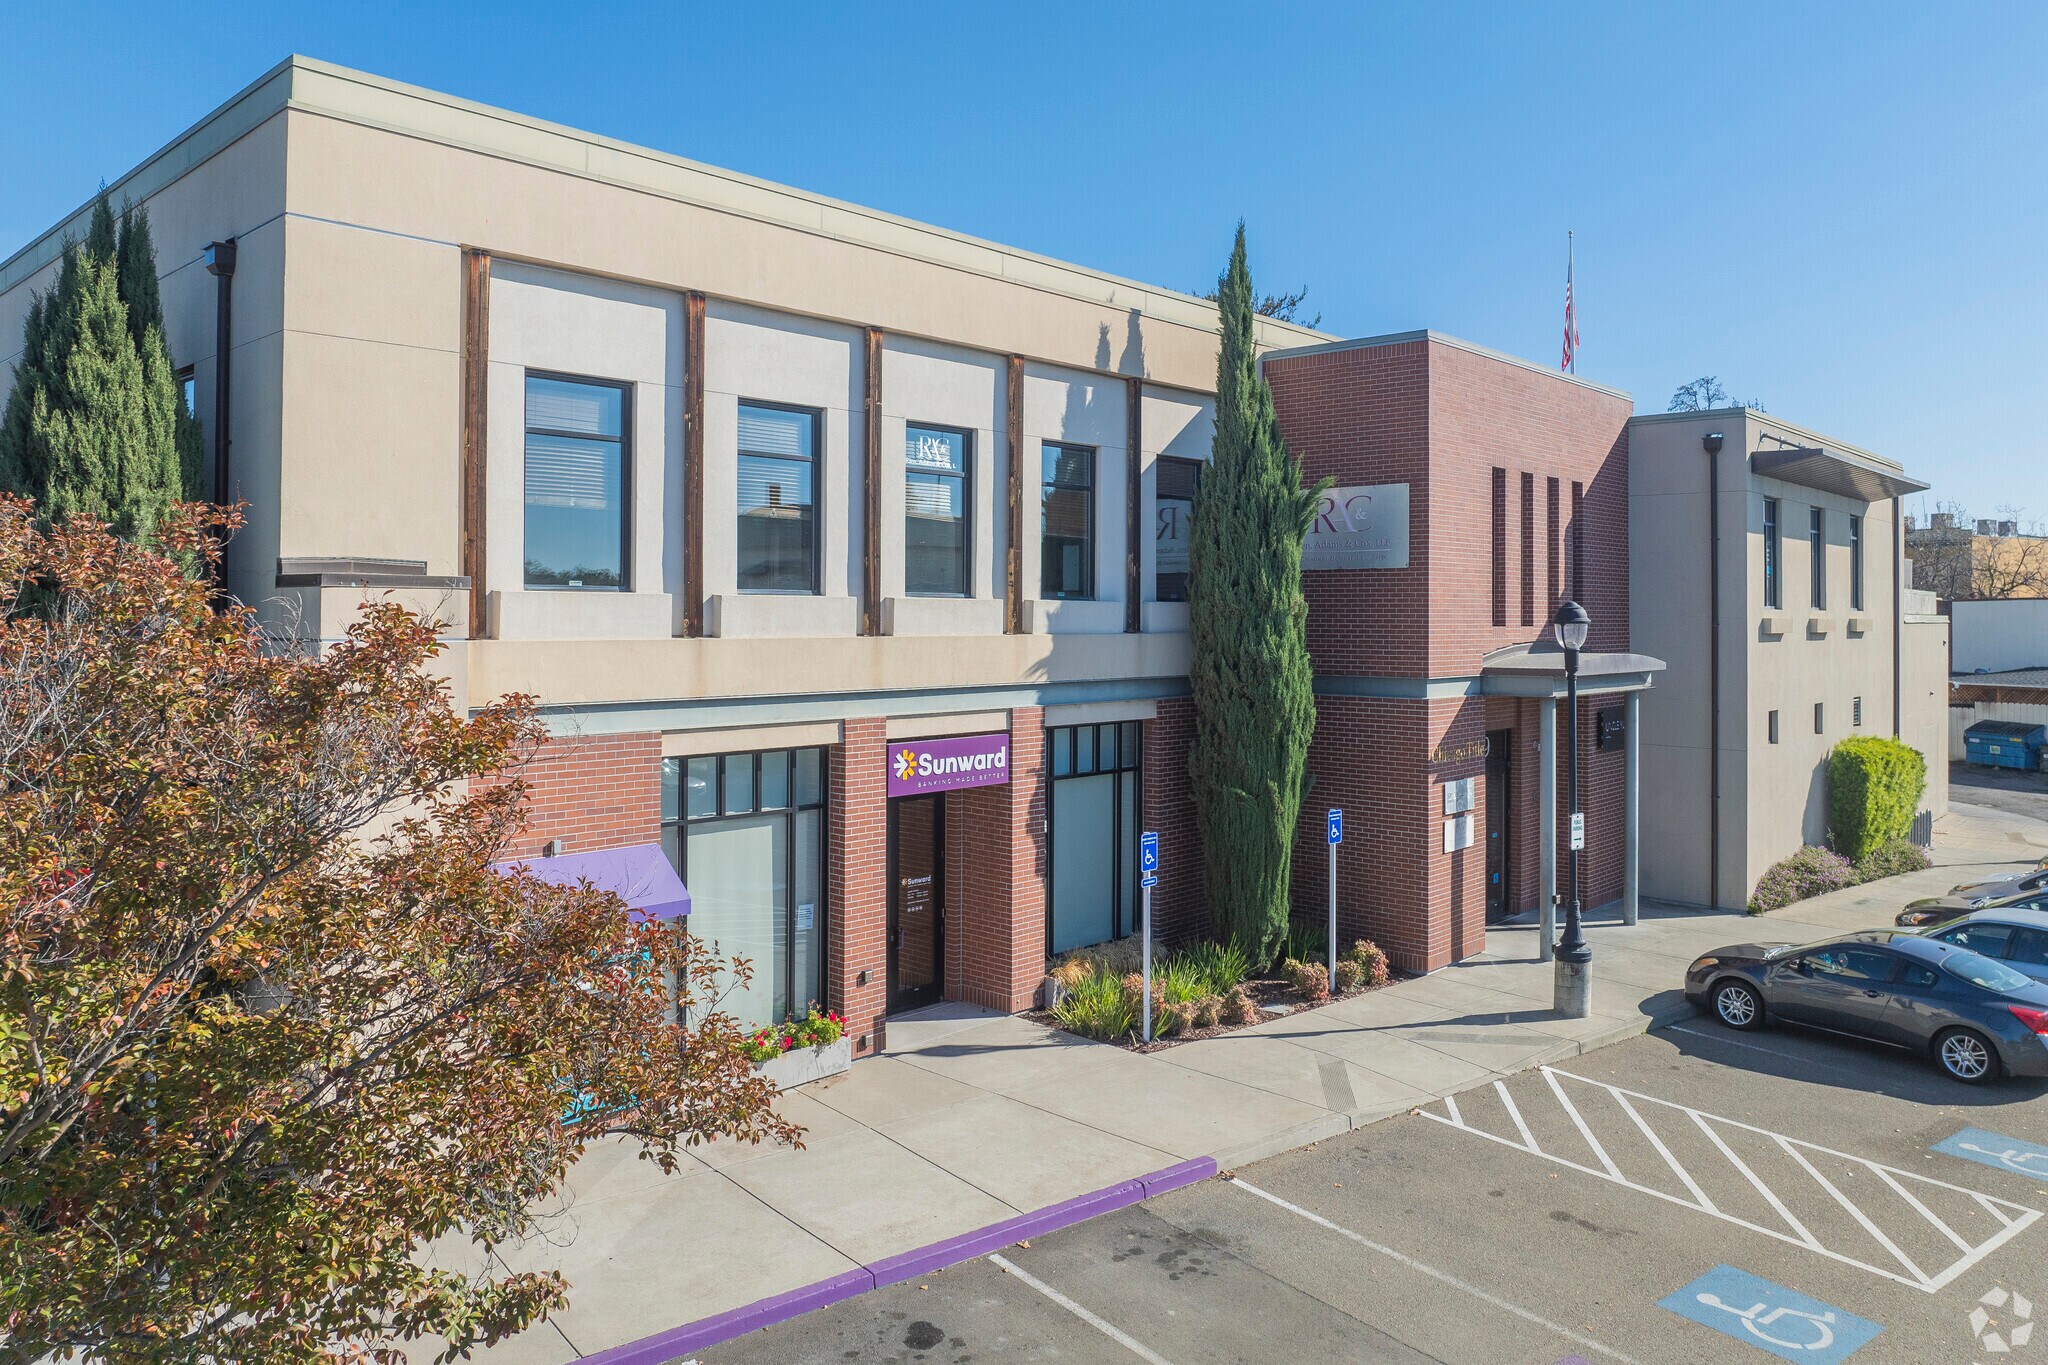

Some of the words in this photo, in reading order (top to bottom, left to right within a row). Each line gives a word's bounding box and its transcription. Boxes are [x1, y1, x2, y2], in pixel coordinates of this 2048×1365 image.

[1315, 540, 1343, 549] Adams
[1346, 540, 1354, 549] &
[1376, 538, 1391, 547] LLP
[919, 746, 1006, 776] Sunward
[1431, 746, 1466, 765] Chicago
[1467, 741, 1485, 758] Title
[918, 778, 952, 788] BANKING
[979, 772, 1005, 781] BETTER
[908, 875, 931, 884] Sunward
